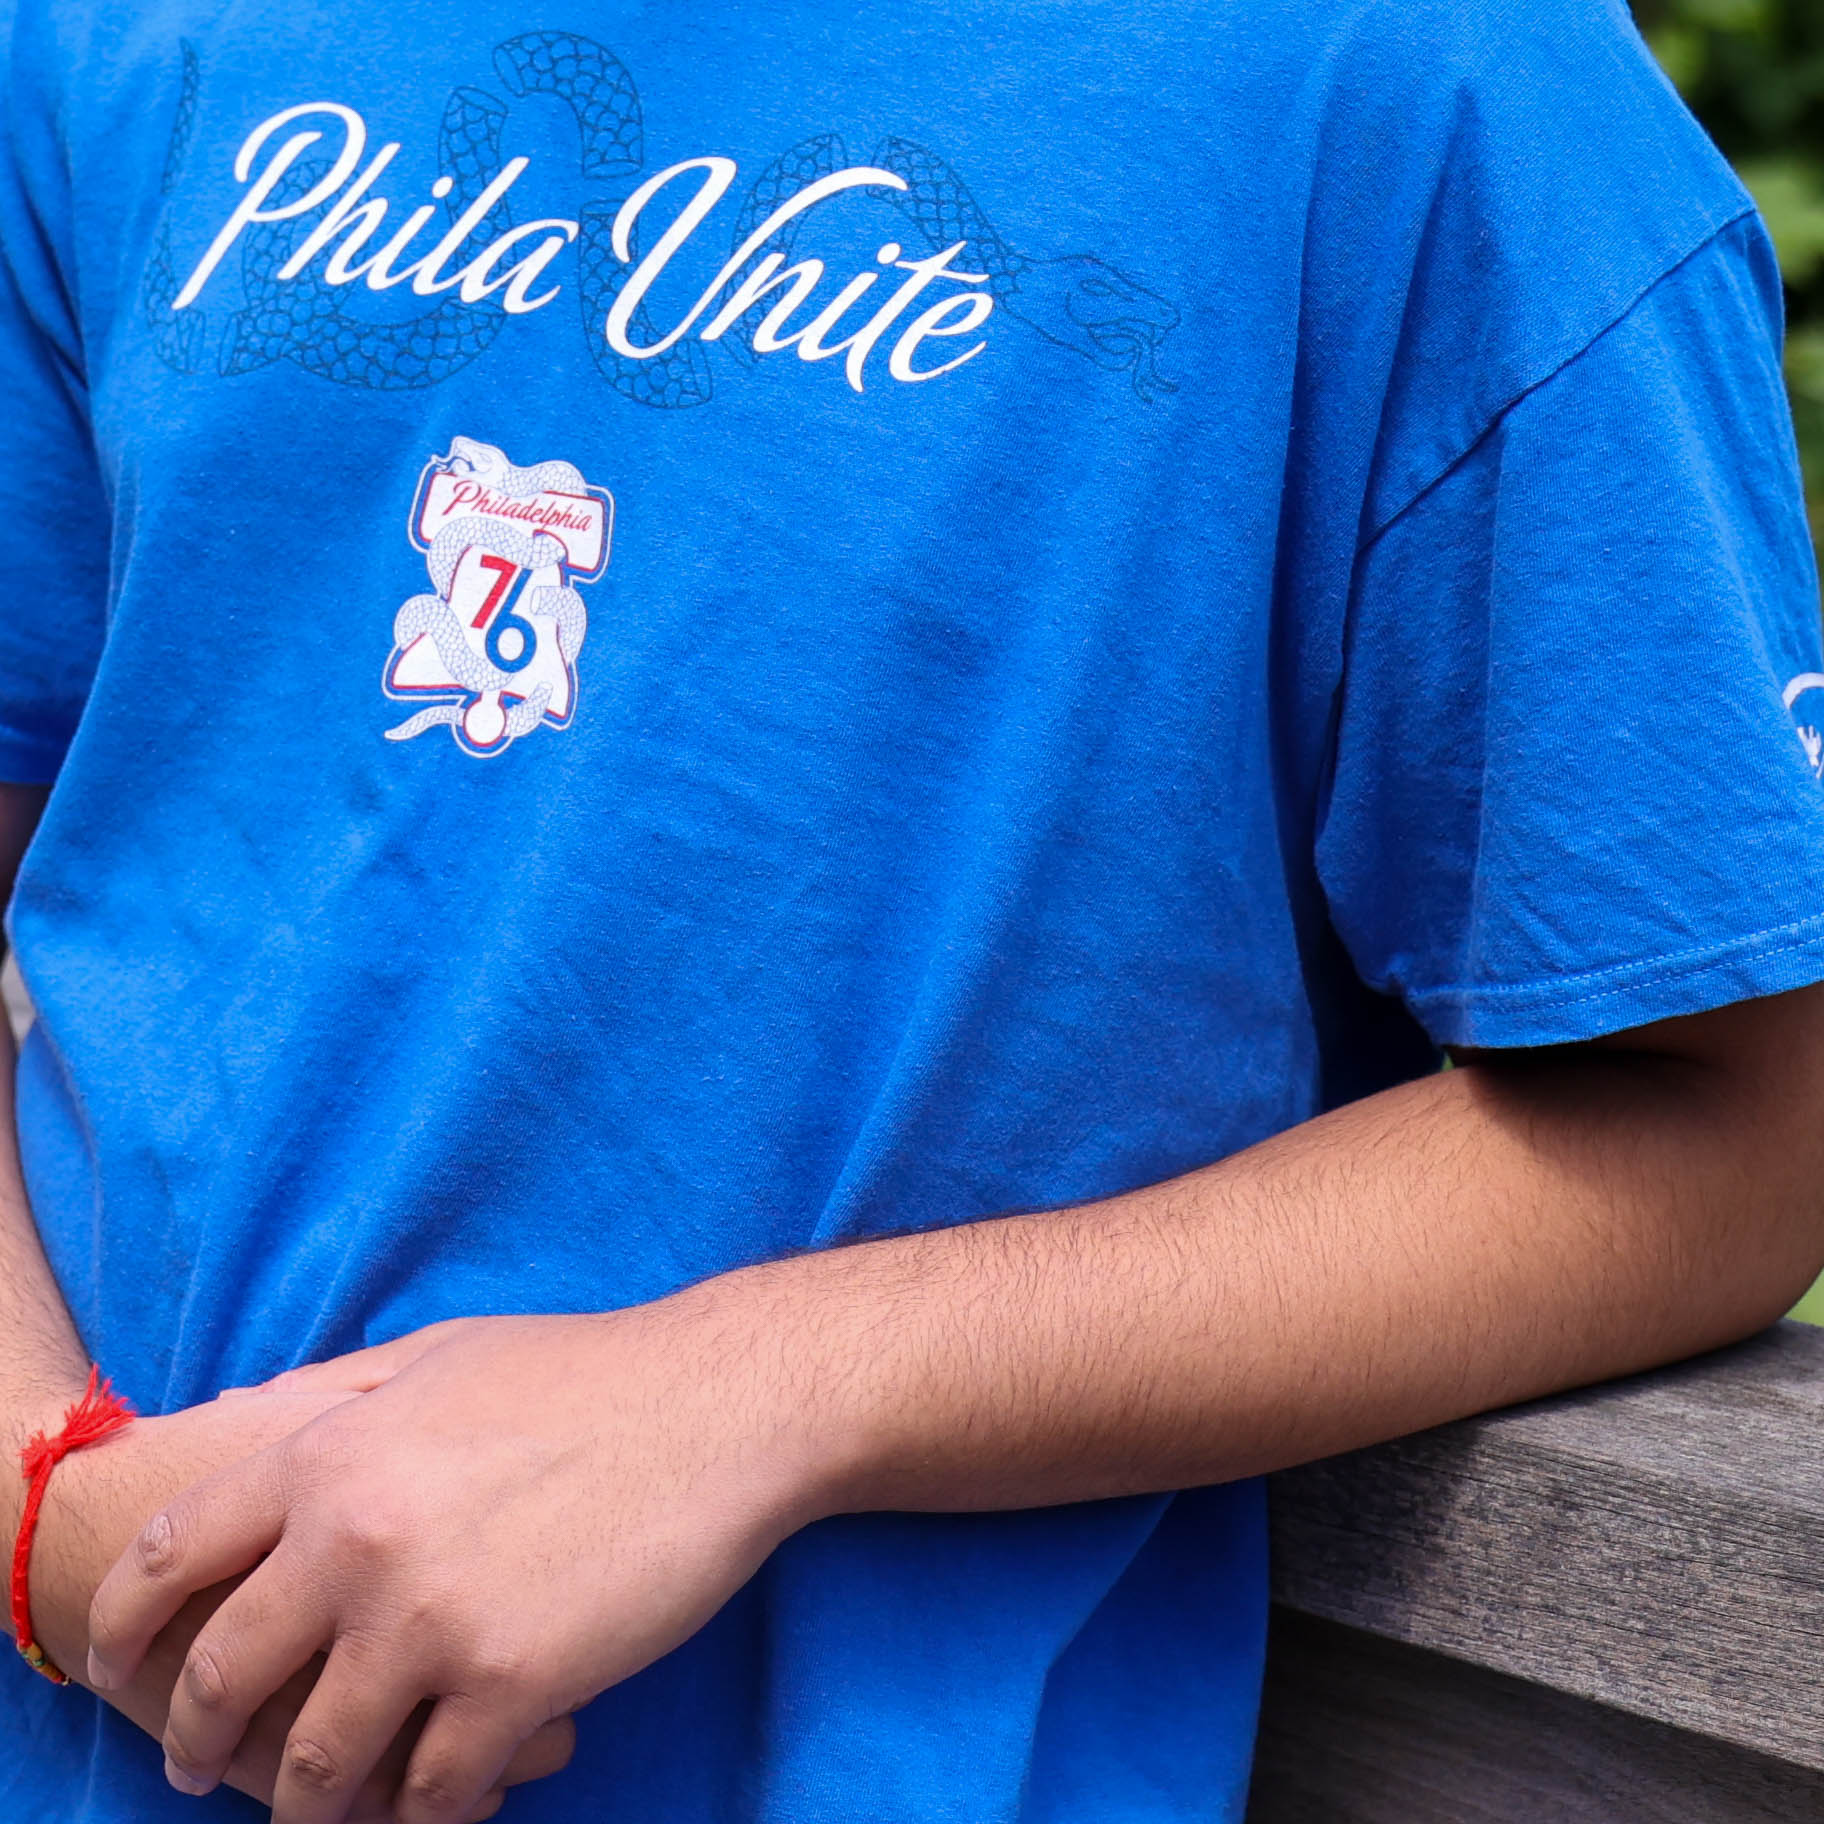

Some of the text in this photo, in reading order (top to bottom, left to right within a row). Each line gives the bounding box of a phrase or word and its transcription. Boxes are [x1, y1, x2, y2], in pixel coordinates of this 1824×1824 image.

[172, 102, 994, 393] Phila Unite
[442, 479, 592, 532] Philadelphia
[470, 553, 537, 673] 76
